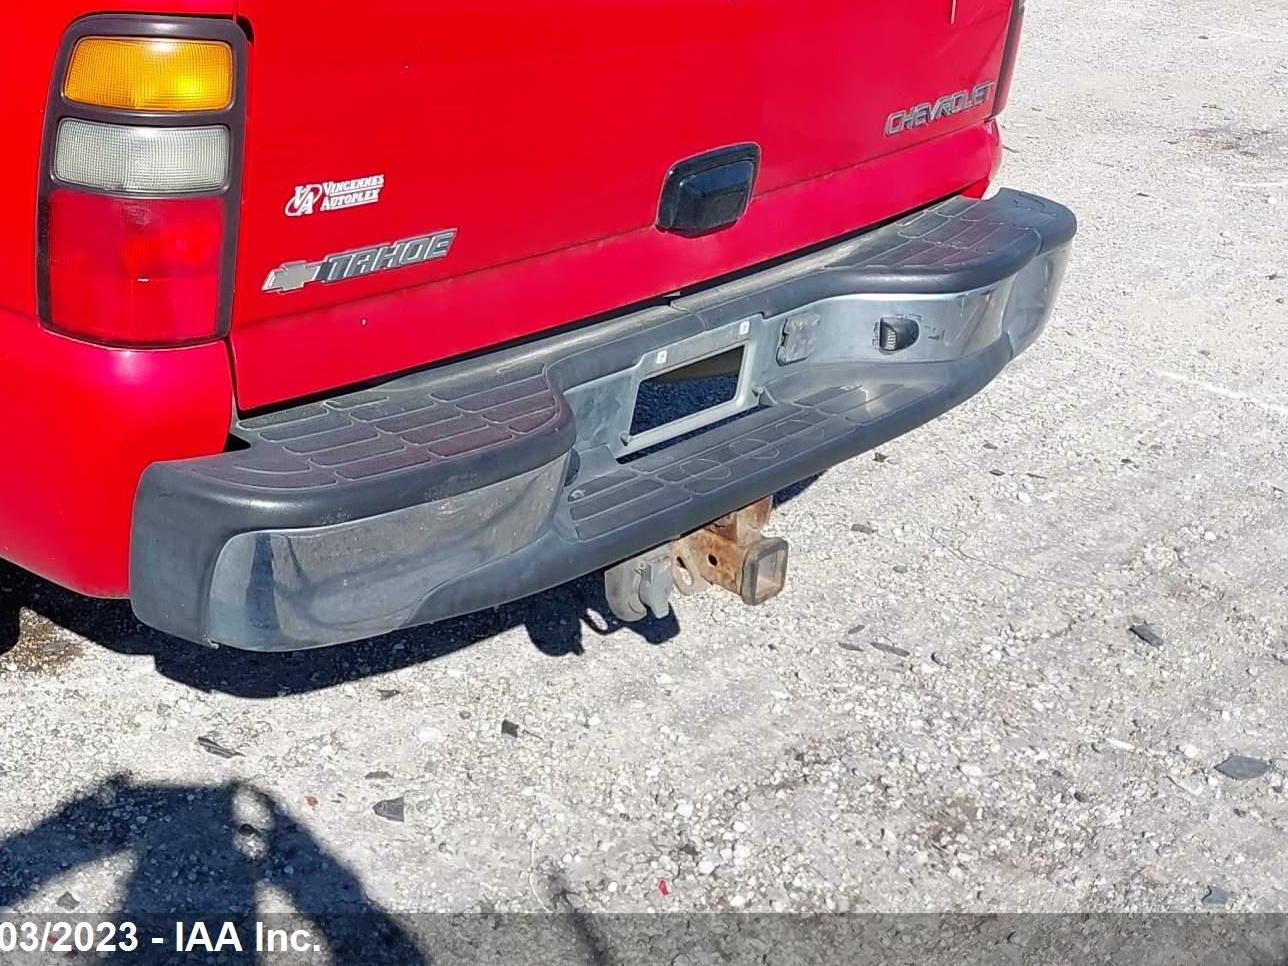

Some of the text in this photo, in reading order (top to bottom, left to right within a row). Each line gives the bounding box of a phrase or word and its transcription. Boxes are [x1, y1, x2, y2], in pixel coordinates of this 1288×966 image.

[885, 81, 995, 137] CHEVROLET
[320, 189, 381, 212] AUTOPLEX
[322, 229, 457, 283] TAHOE
